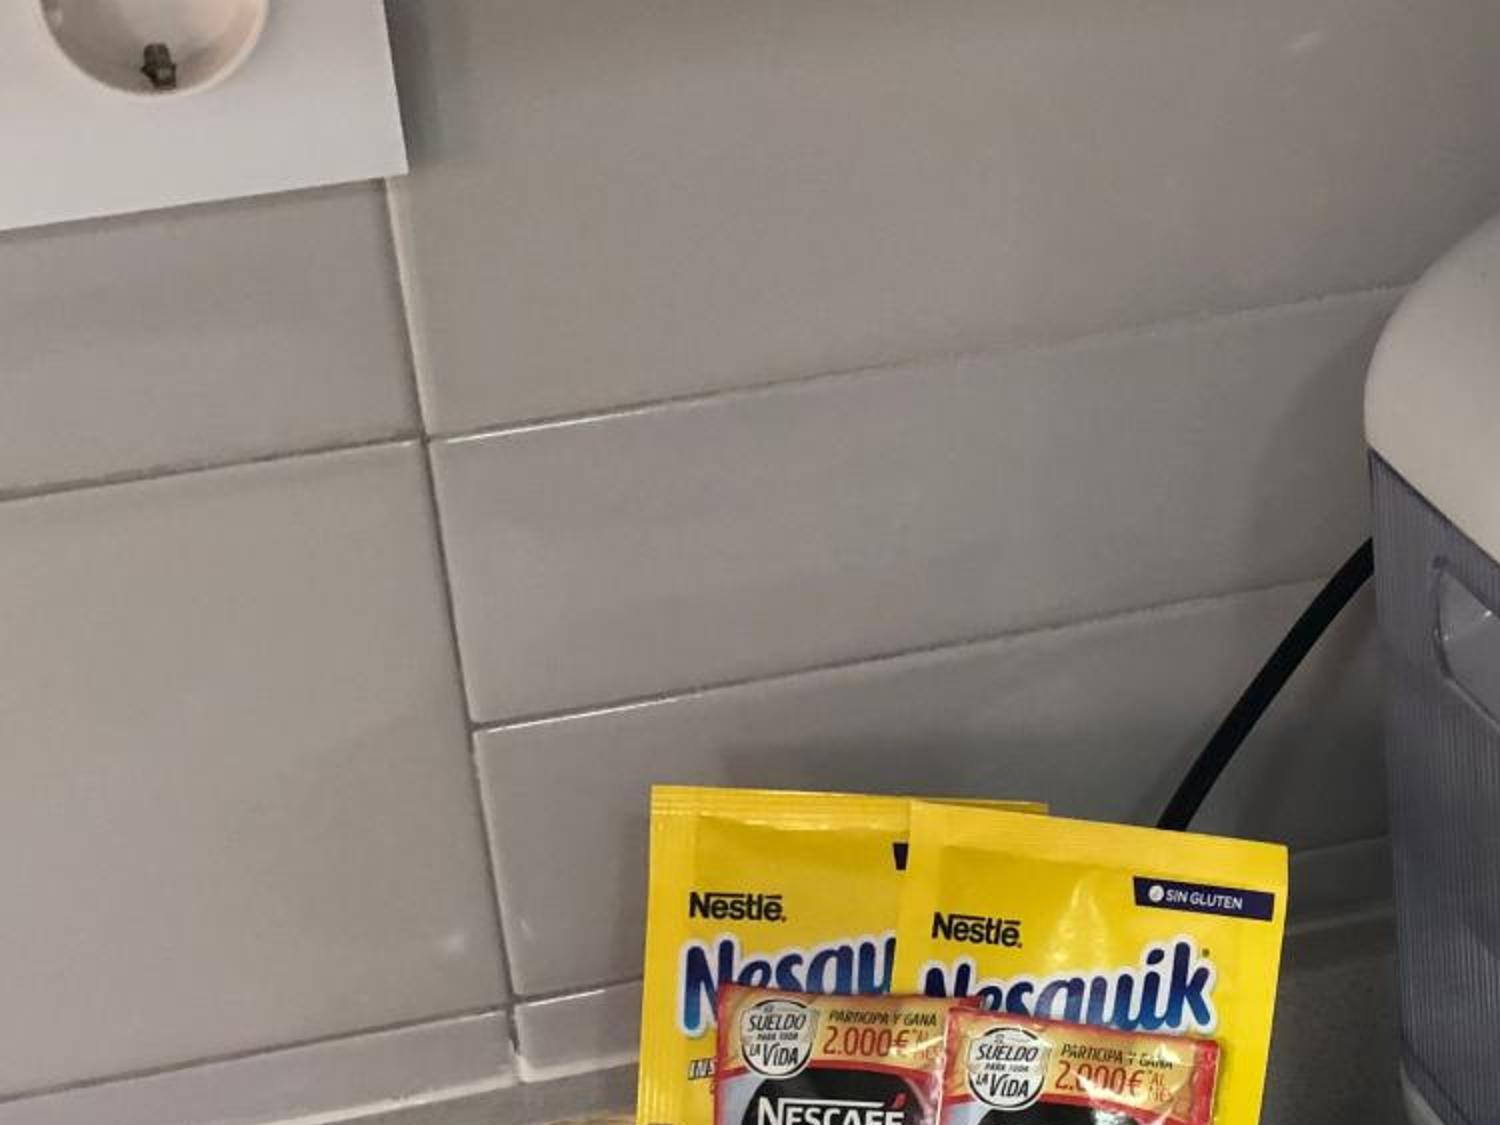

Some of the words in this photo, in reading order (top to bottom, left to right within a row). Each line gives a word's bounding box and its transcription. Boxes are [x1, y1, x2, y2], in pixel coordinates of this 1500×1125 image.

[689, 891, 785, 922] Nestlé
[1165, 888, 1189, 903] SIN
[1189, 891, 1244, 910] GLUTEN
[931, 911, 1021, 947] Nestlé
[748, 1013, 807, 1032] SUELDO
[828, 1009, 891, 1025] PARTICIPA
[892, 1012, 902, 1025] Y
[903, 1013, 937, 1026] GANA
[975, 1043, 1039, 1062] SUELDO
[1060, 1043, 1123, 1064] PARTICIPA
